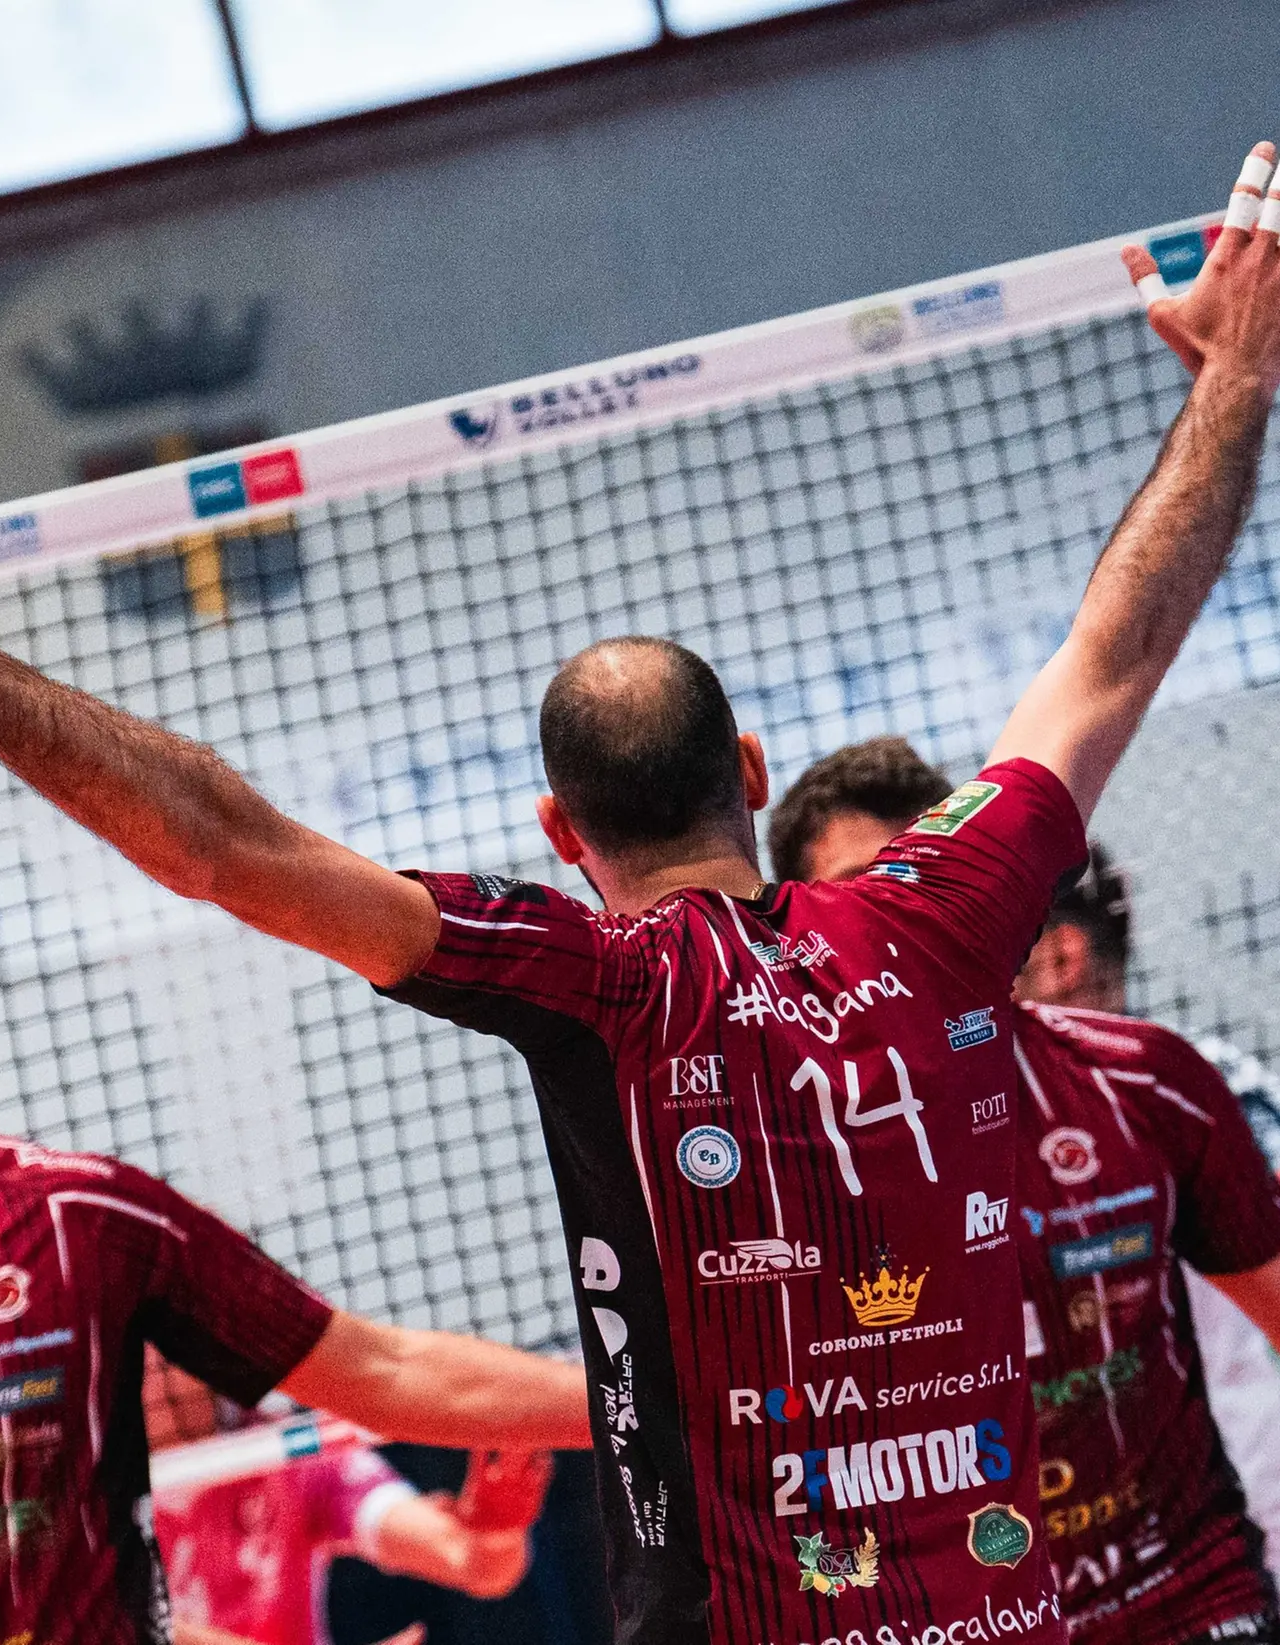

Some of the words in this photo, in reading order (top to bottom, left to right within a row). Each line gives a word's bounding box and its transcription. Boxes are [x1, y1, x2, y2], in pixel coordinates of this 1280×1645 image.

[511, 354, 702, 414] BELLUNO
[668, 1055, 725, 1096] B&F
[663, 1096, 735, 1110] MANAGEMENT
[790, 1046, 938, 1197] 14
[971, 1092, 1007, 1124] FOTI
[734, 1273, 789, 1284] TRASPORTI
[809, 1333, 885, 1356] CORONA
[889, 1318, 964, 1343] PETROLI
[600, 1383, 618, 1426] per
[728, 1374, 869, 1426] ROVA
[875, 1372, 975, 1409] service
[977, 1354, 1022, 1389] S.r.l.
